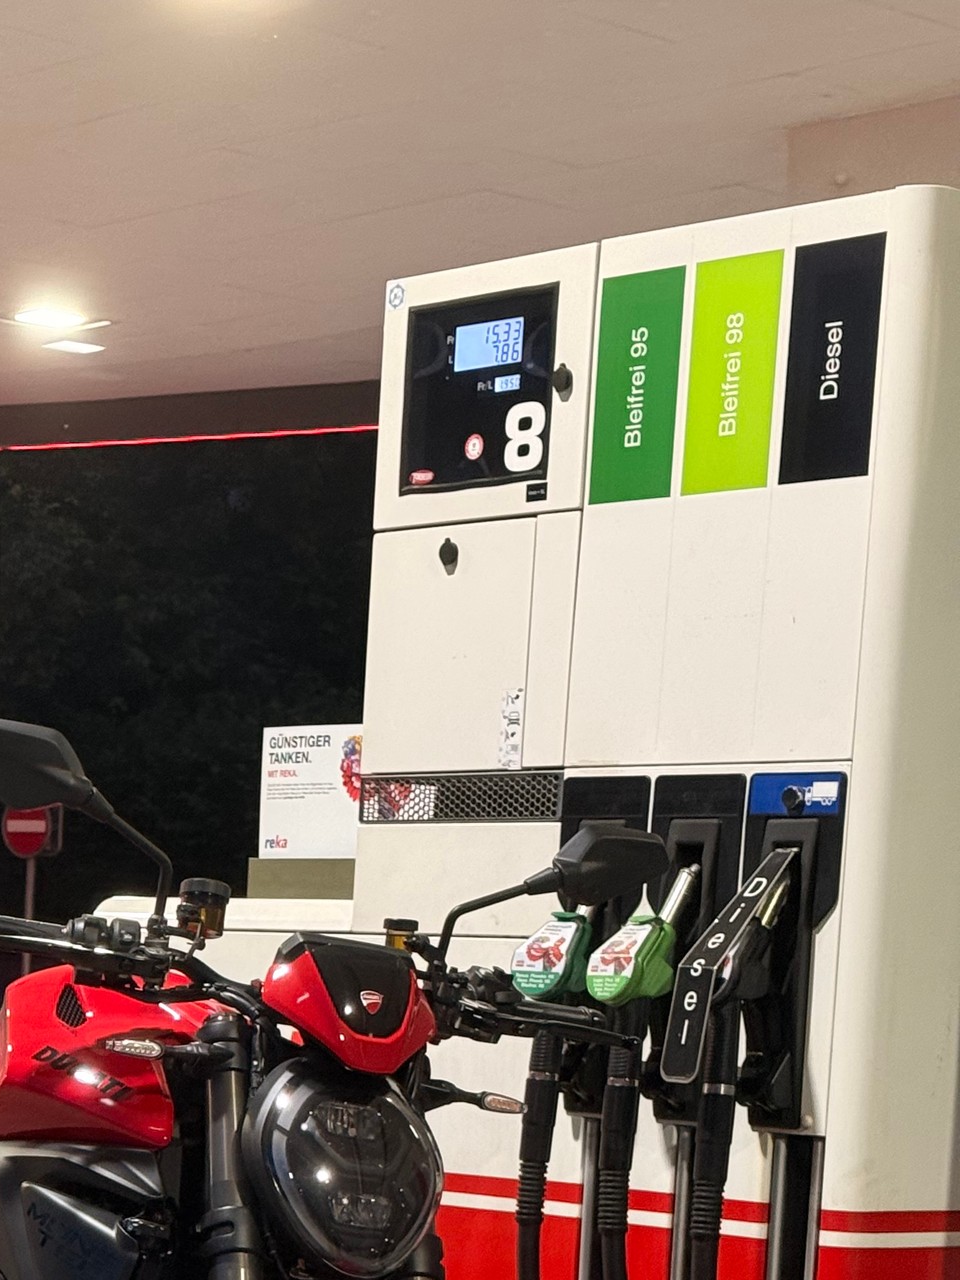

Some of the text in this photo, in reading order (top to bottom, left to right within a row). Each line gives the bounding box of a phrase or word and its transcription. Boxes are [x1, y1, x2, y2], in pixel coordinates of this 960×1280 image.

[624, 326, 649, 448] Bleifrei 95
[718, 312, 744, 437] Bleifrei 98
[819, 320, 843, 400] Diesel
[504, 401, 546, 472] 8
[269, 733, 332, 750] GÜNSTIGER
[269, 751, 313, 765] TANKEN.
[264, 834, 289, 850] reka
[680, 877, 768, 1046] Diesel
[31, 1045, 134, 1102] DUTI
